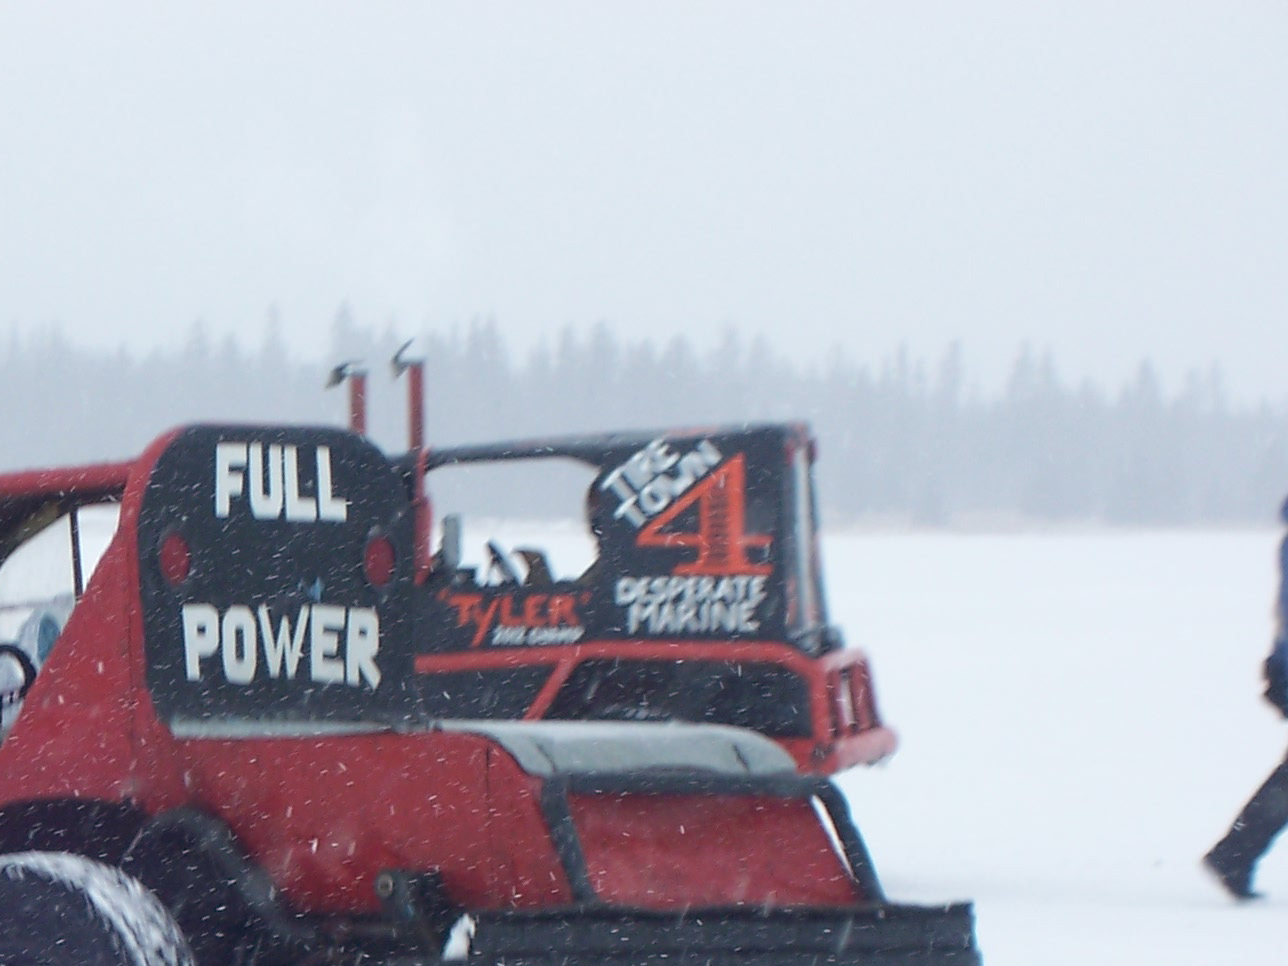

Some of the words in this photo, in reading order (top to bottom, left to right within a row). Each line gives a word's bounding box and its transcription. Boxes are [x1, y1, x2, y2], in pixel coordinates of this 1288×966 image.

[215, 441, 348, 523] FULL
[613, 439, 723, 529] TOWN
[636, 451, 775, 576] 4
[615, 575, 768, 606] DESPERATE
[628, 600, 761, 635] MARINE
[181, 601, 382, 690] POWER
